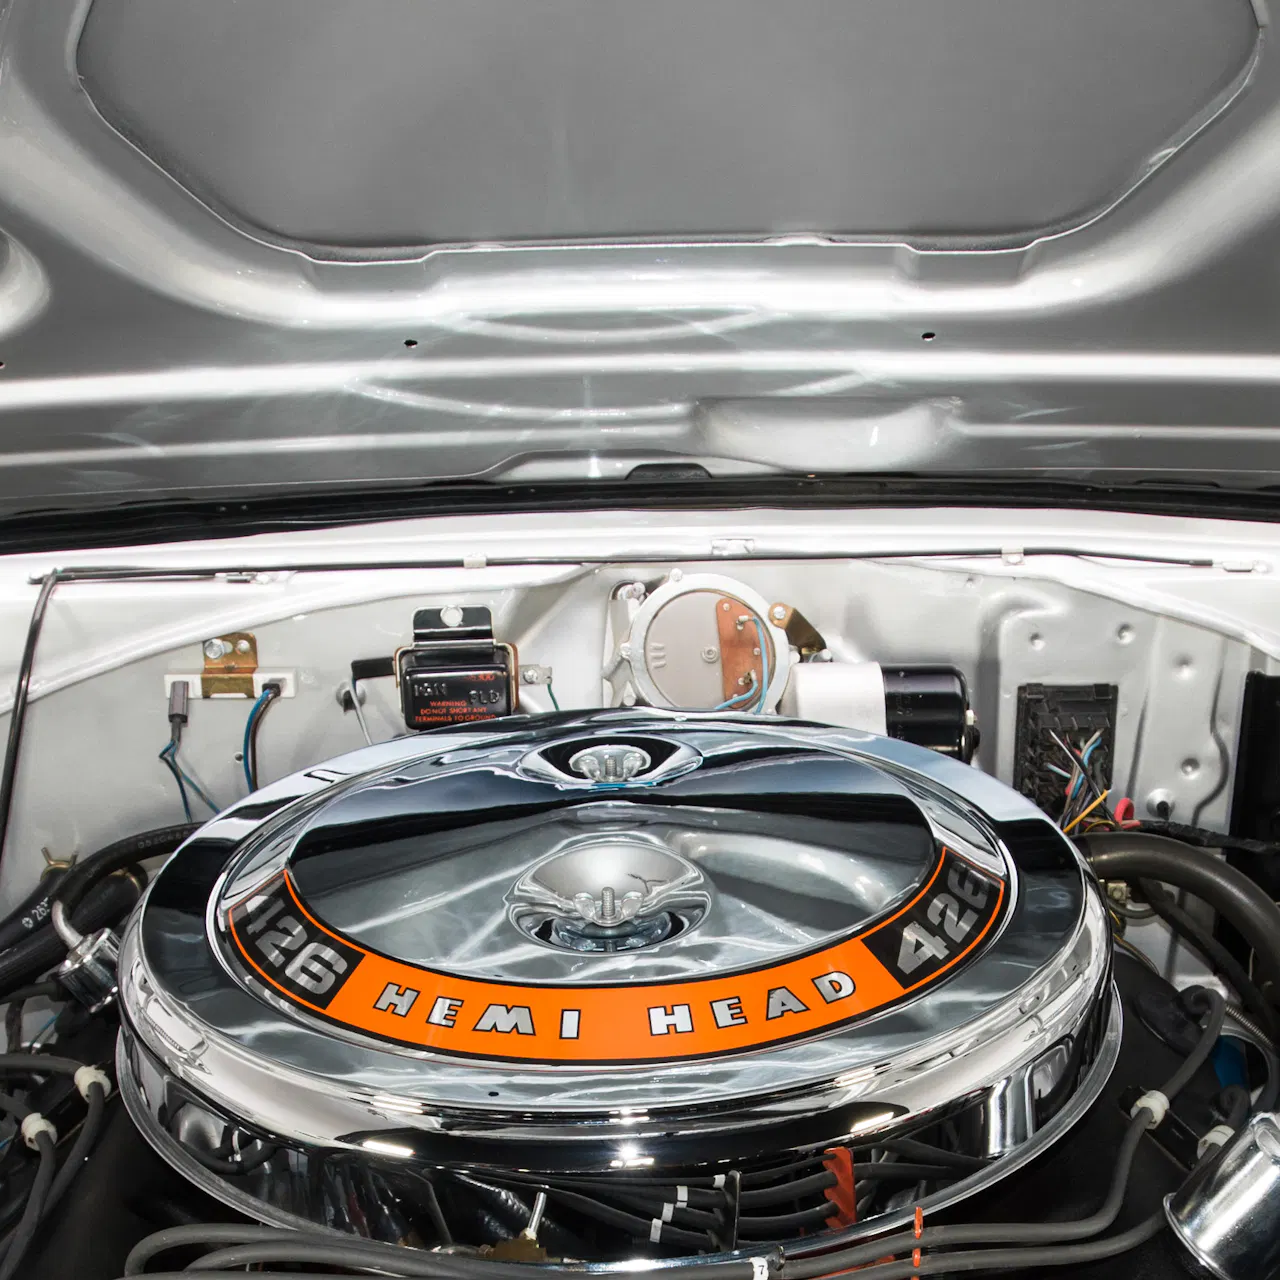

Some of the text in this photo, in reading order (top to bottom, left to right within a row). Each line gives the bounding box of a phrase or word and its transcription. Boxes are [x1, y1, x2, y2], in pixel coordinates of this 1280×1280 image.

[893, 863, 994, 965] 426
[373, 971, 858, 1039] HEMI HEAD
[758, 1265, 765, 1274] 7
